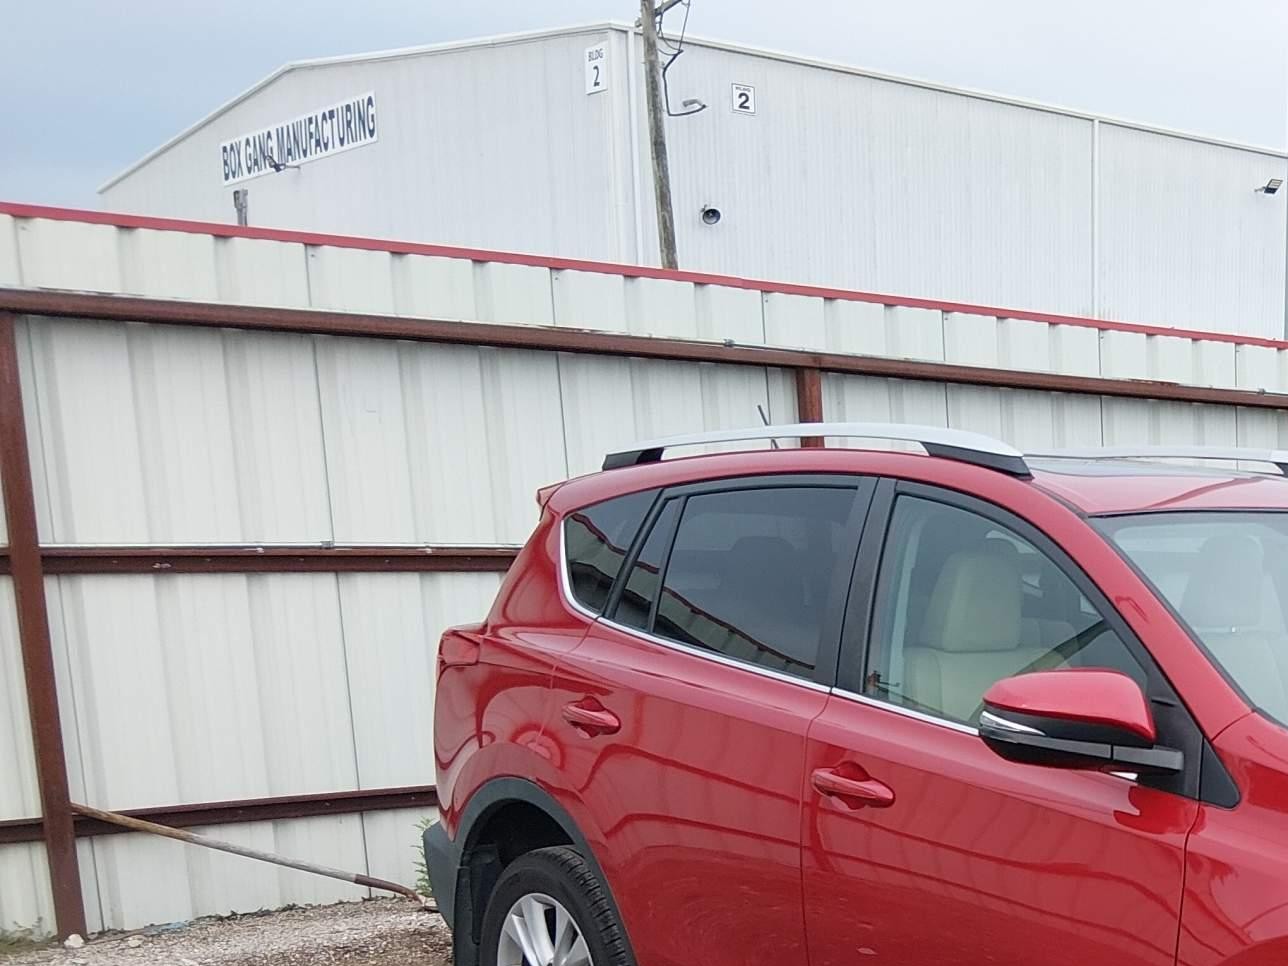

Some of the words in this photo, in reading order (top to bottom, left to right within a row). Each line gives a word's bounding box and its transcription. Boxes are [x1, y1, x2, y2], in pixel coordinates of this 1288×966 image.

[588, 48, 604, 62] BLDG
[593, 65, 601, 87] 2
[738, 92, 750, 110] 2
[222, 139, 243, 181] BOX
[244, 130, 274, 175] GANG
[276, 95, 376, 164] MANUFACTURING
